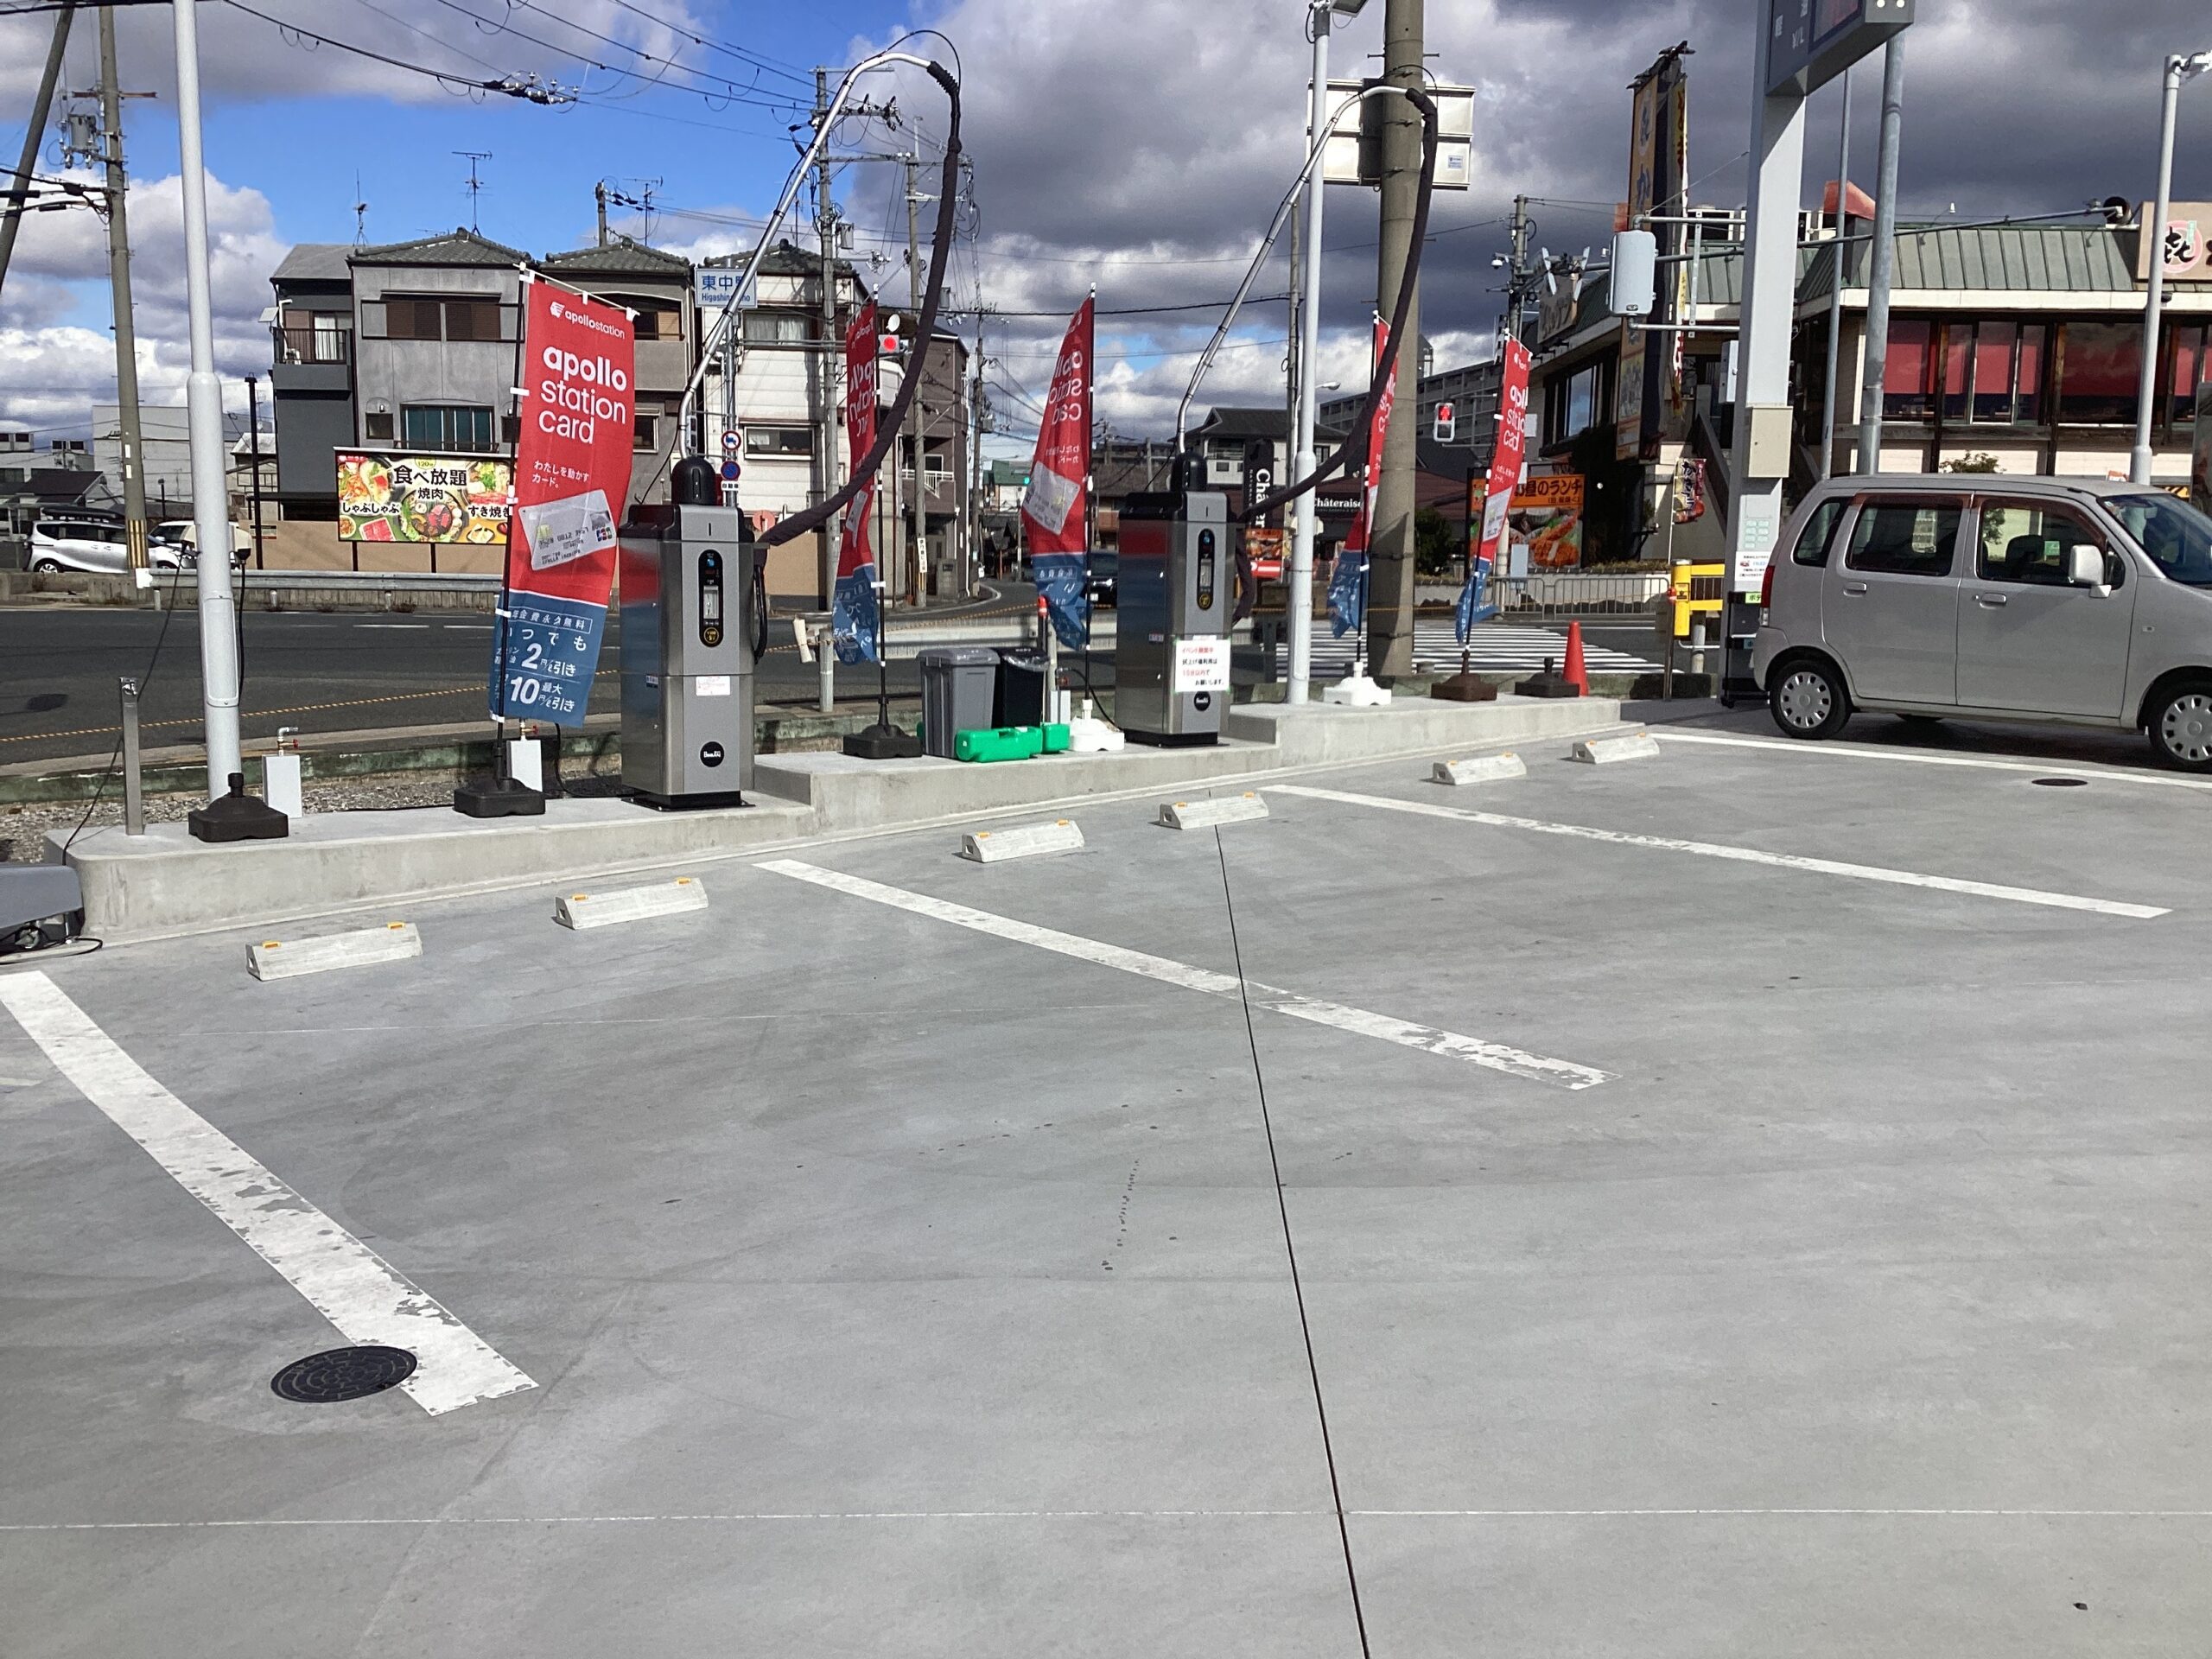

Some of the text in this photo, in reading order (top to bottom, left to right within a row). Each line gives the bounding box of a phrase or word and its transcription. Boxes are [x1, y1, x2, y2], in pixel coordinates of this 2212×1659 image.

[702, 293, 751, 302] Higashinno
[564, 310, 626, 340] apollostation
[543, 346, 627, 391] apollo
[540, 379, 626, 424] station
[538, 410, 595, 444] card
[393, 464, 467, 486] 食べ放題
[534, 460, 589, 482] わたしを動かす
[417, 487, 444, 500] 焼肉
[1314, 497, 1362, 508] hâterais
[342, 502, 400, 514] しゃぶしゃぶ
